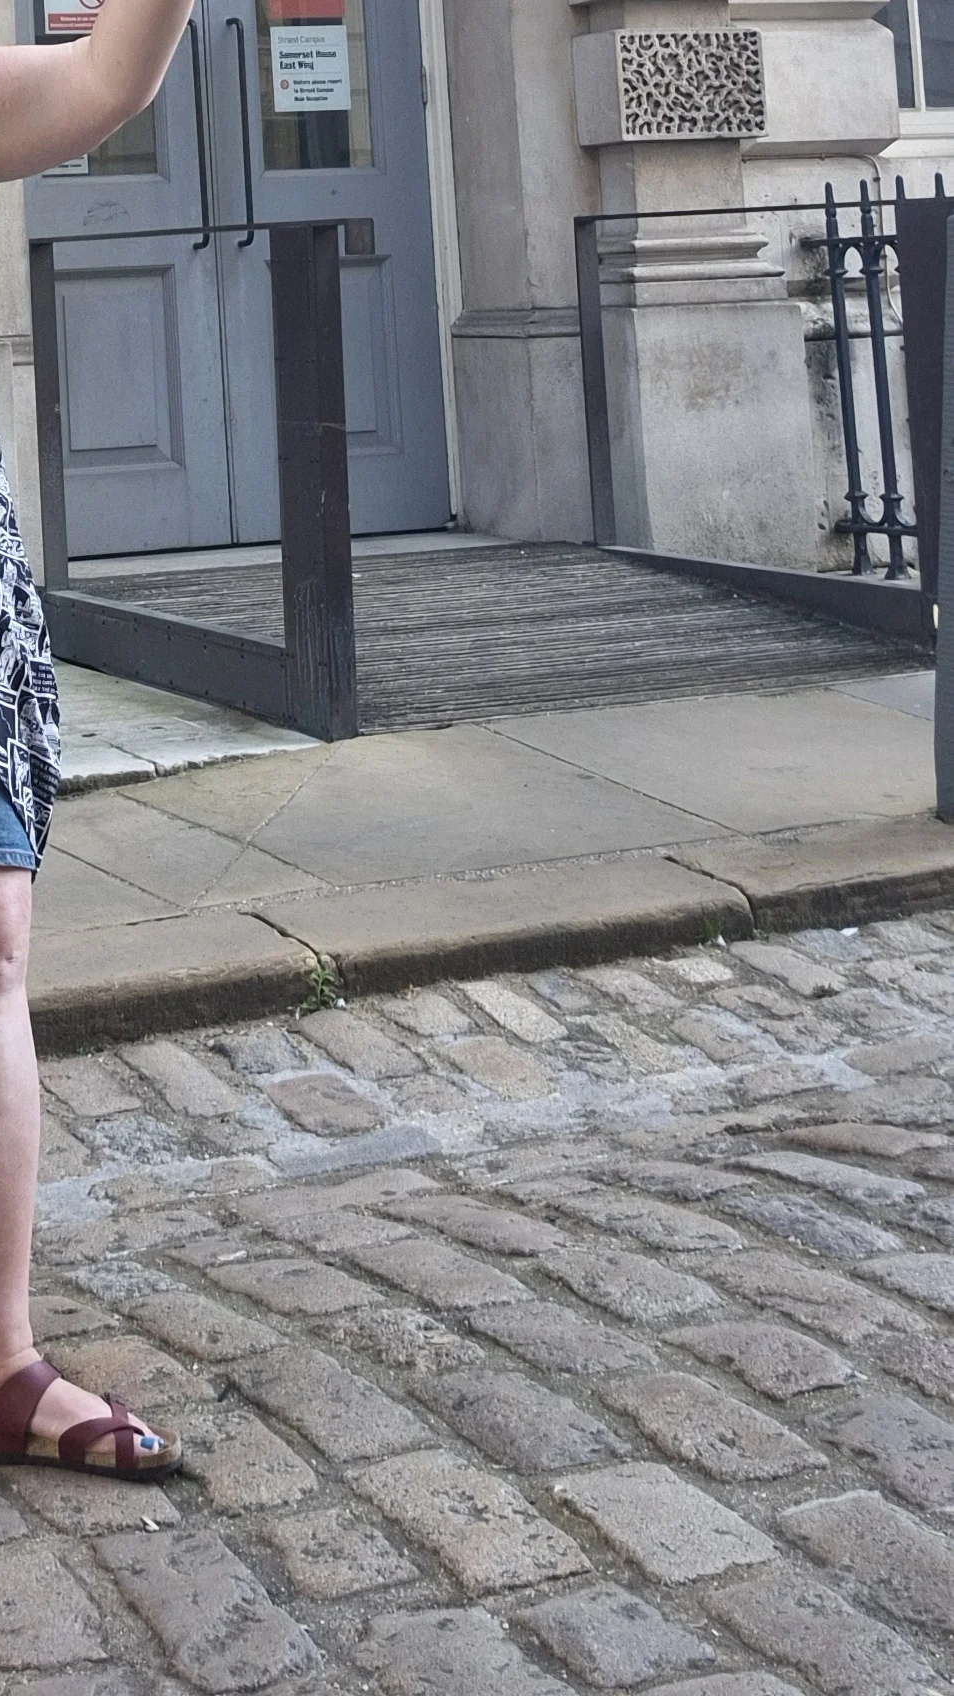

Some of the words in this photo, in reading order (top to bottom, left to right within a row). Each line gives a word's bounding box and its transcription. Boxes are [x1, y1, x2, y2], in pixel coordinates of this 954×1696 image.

[277, 36, 299, 44] Strand
[300, 35, 325, 44] Campus
[279, 50, 313, 59] Somerset
[280, 61, 296, 70] East
[297, 60, 314, 70] Wing
